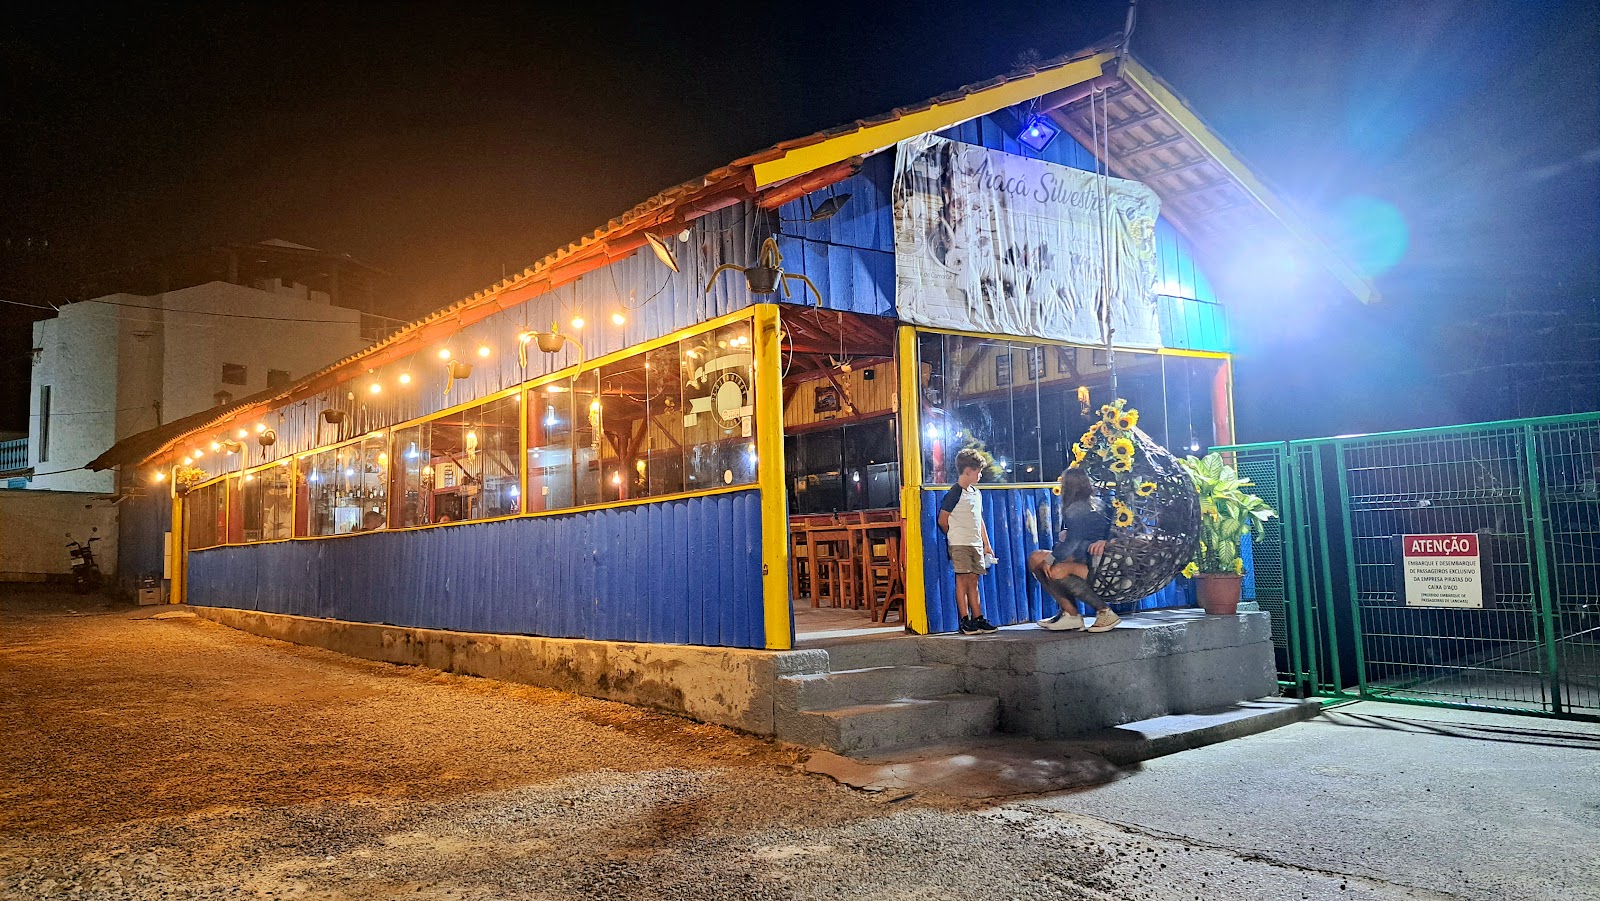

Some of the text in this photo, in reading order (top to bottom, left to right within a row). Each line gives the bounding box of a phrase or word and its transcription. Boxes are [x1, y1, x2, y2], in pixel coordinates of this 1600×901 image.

[972, 158, 1106, 213] Araçá Silvestre
[1411, 536, 1469, 555] ATENÇÃO
